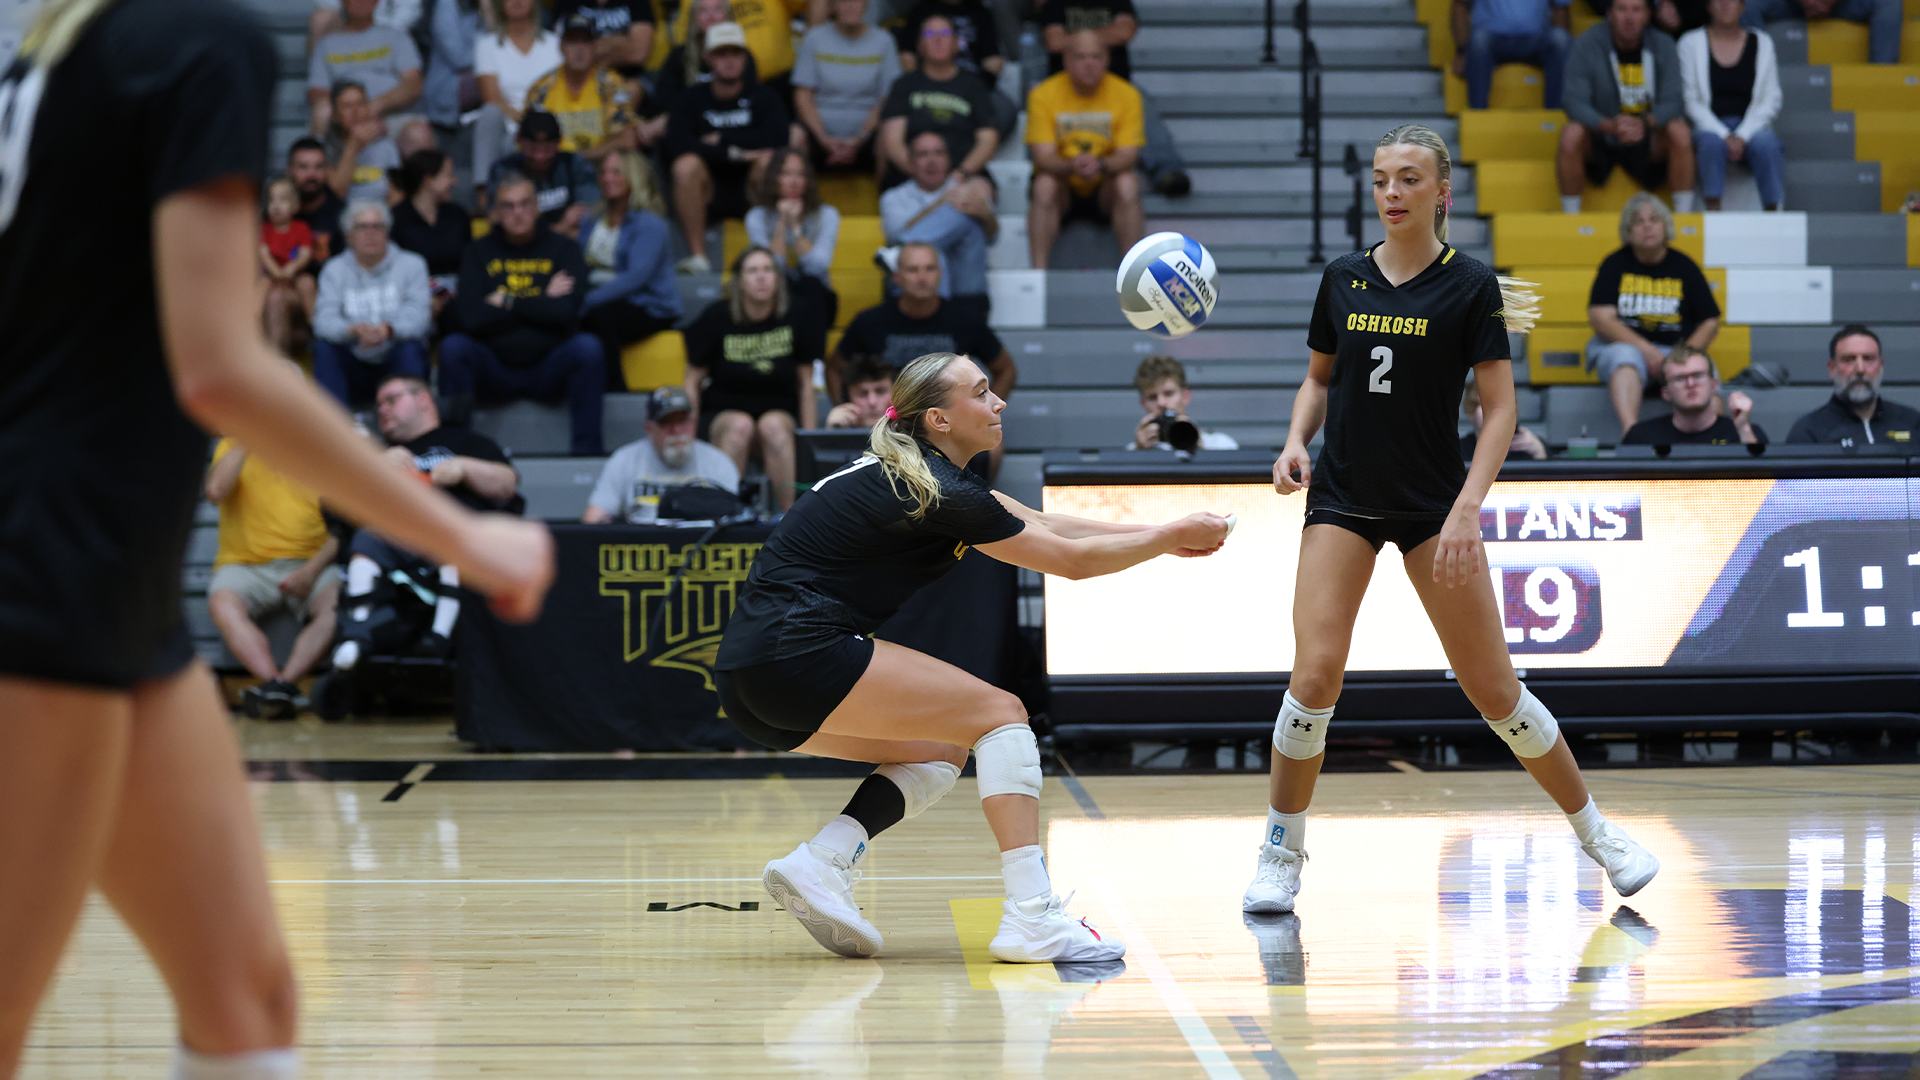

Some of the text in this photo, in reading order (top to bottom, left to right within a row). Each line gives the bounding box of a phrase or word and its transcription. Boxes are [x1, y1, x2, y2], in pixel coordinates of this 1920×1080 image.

[1162, 275, 1202, 318] NCAA
[1175, 260, 1213, 308] molten
[1346, 312, 1429, 337] OSHKOSH
[1368, 345, 1393, 394] 2
[1480, 496, 1628, 541] TANS
